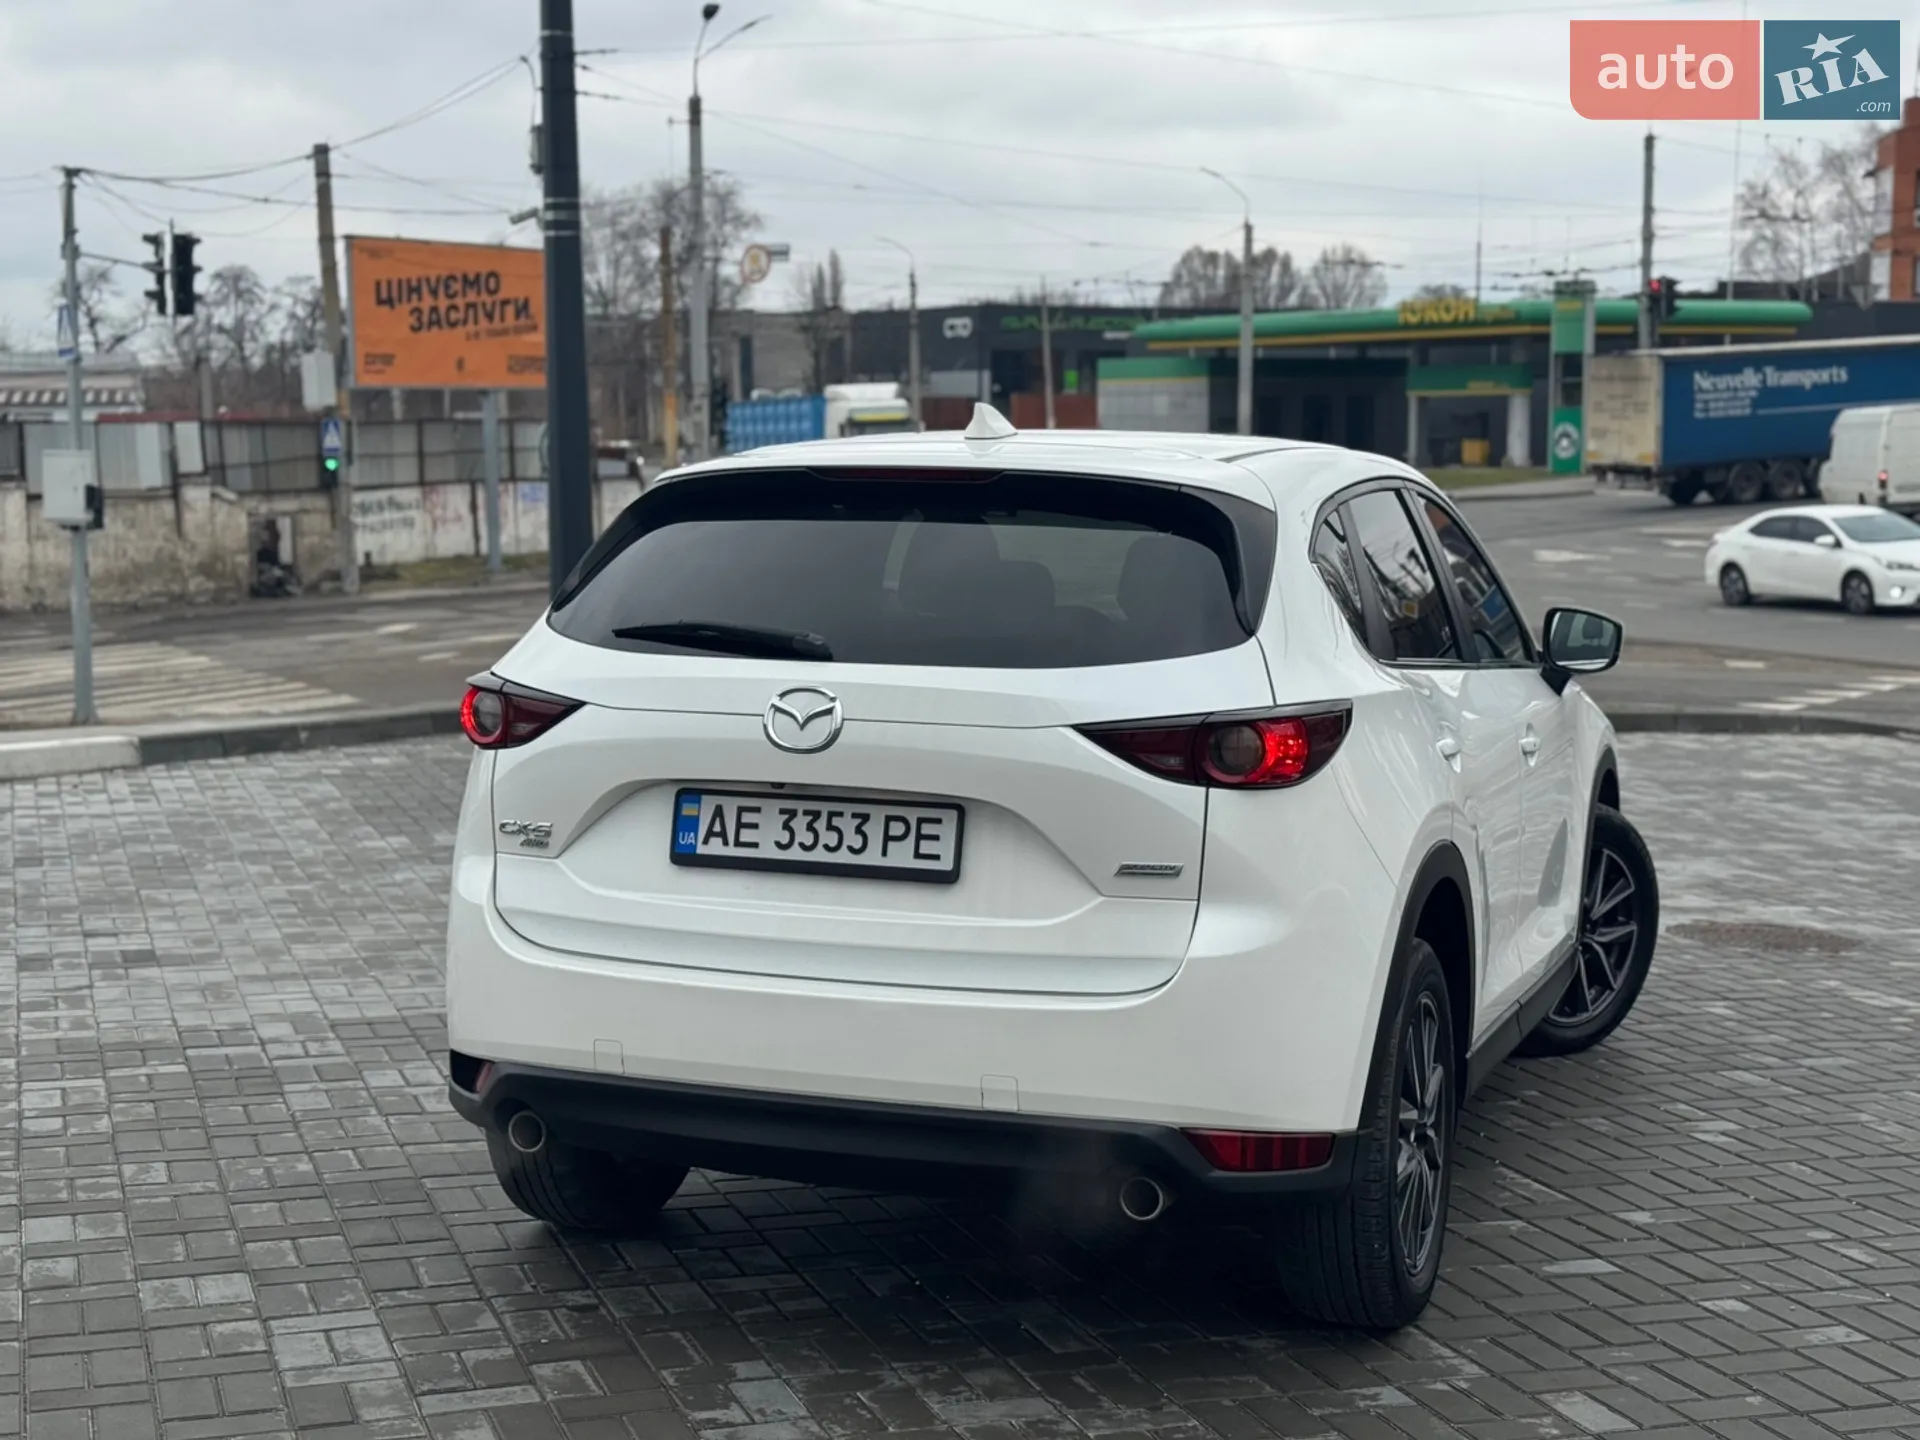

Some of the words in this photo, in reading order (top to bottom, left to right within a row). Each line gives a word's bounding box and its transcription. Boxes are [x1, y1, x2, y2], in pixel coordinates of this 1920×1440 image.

[374, 270, 502, 310] ЦІНУЄМО
[1762, 364, 1849, 391] Transports
[678, 831, 697, 846] UA
[701, 803, 762, 849] AE
[773, 807, 871, 856] 3353
[881, 814, 943, 862] PE
